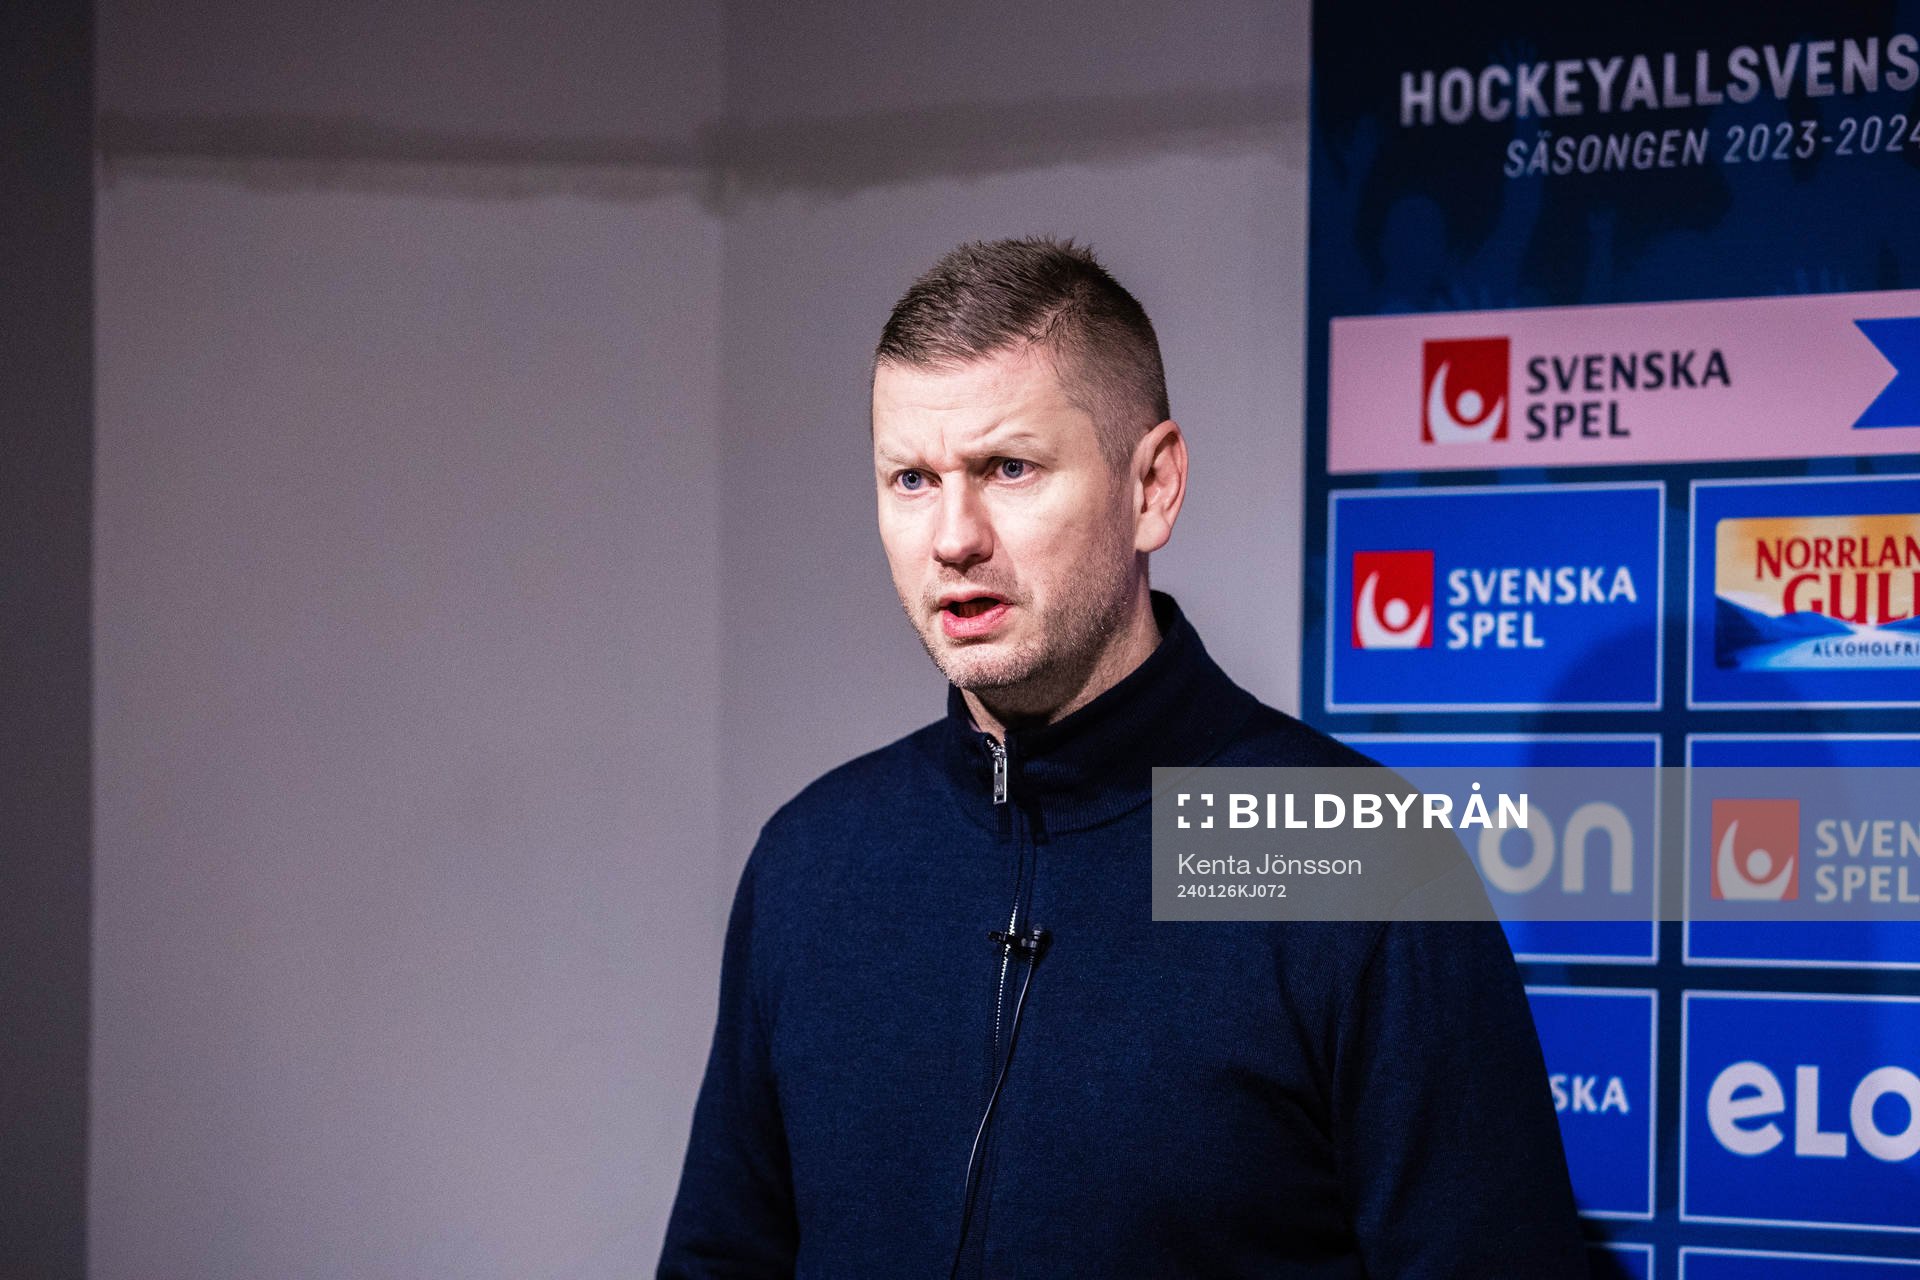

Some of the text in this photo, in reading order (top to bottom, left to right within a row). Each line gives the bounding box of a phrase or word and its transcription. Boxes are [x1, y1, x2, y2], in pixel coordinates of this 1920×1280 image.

[1400, 33, 1919, 126] HOCKEYALLSVENS
[1503, 129, 1709, 178] SÄSONGEN
[1526, 349, 1732, 395] SVENSKA
[1526, 401, 1631, 441] SPEL
[1447, 566, 1637, 606] SVENSKA
[1783, 572, 1920, 626] GUL
[1447, 612, 1544, 649] SPEL
[1815, 819, 1920, 858] SVEN
[1815, 865, 1920, 903] SPEL
